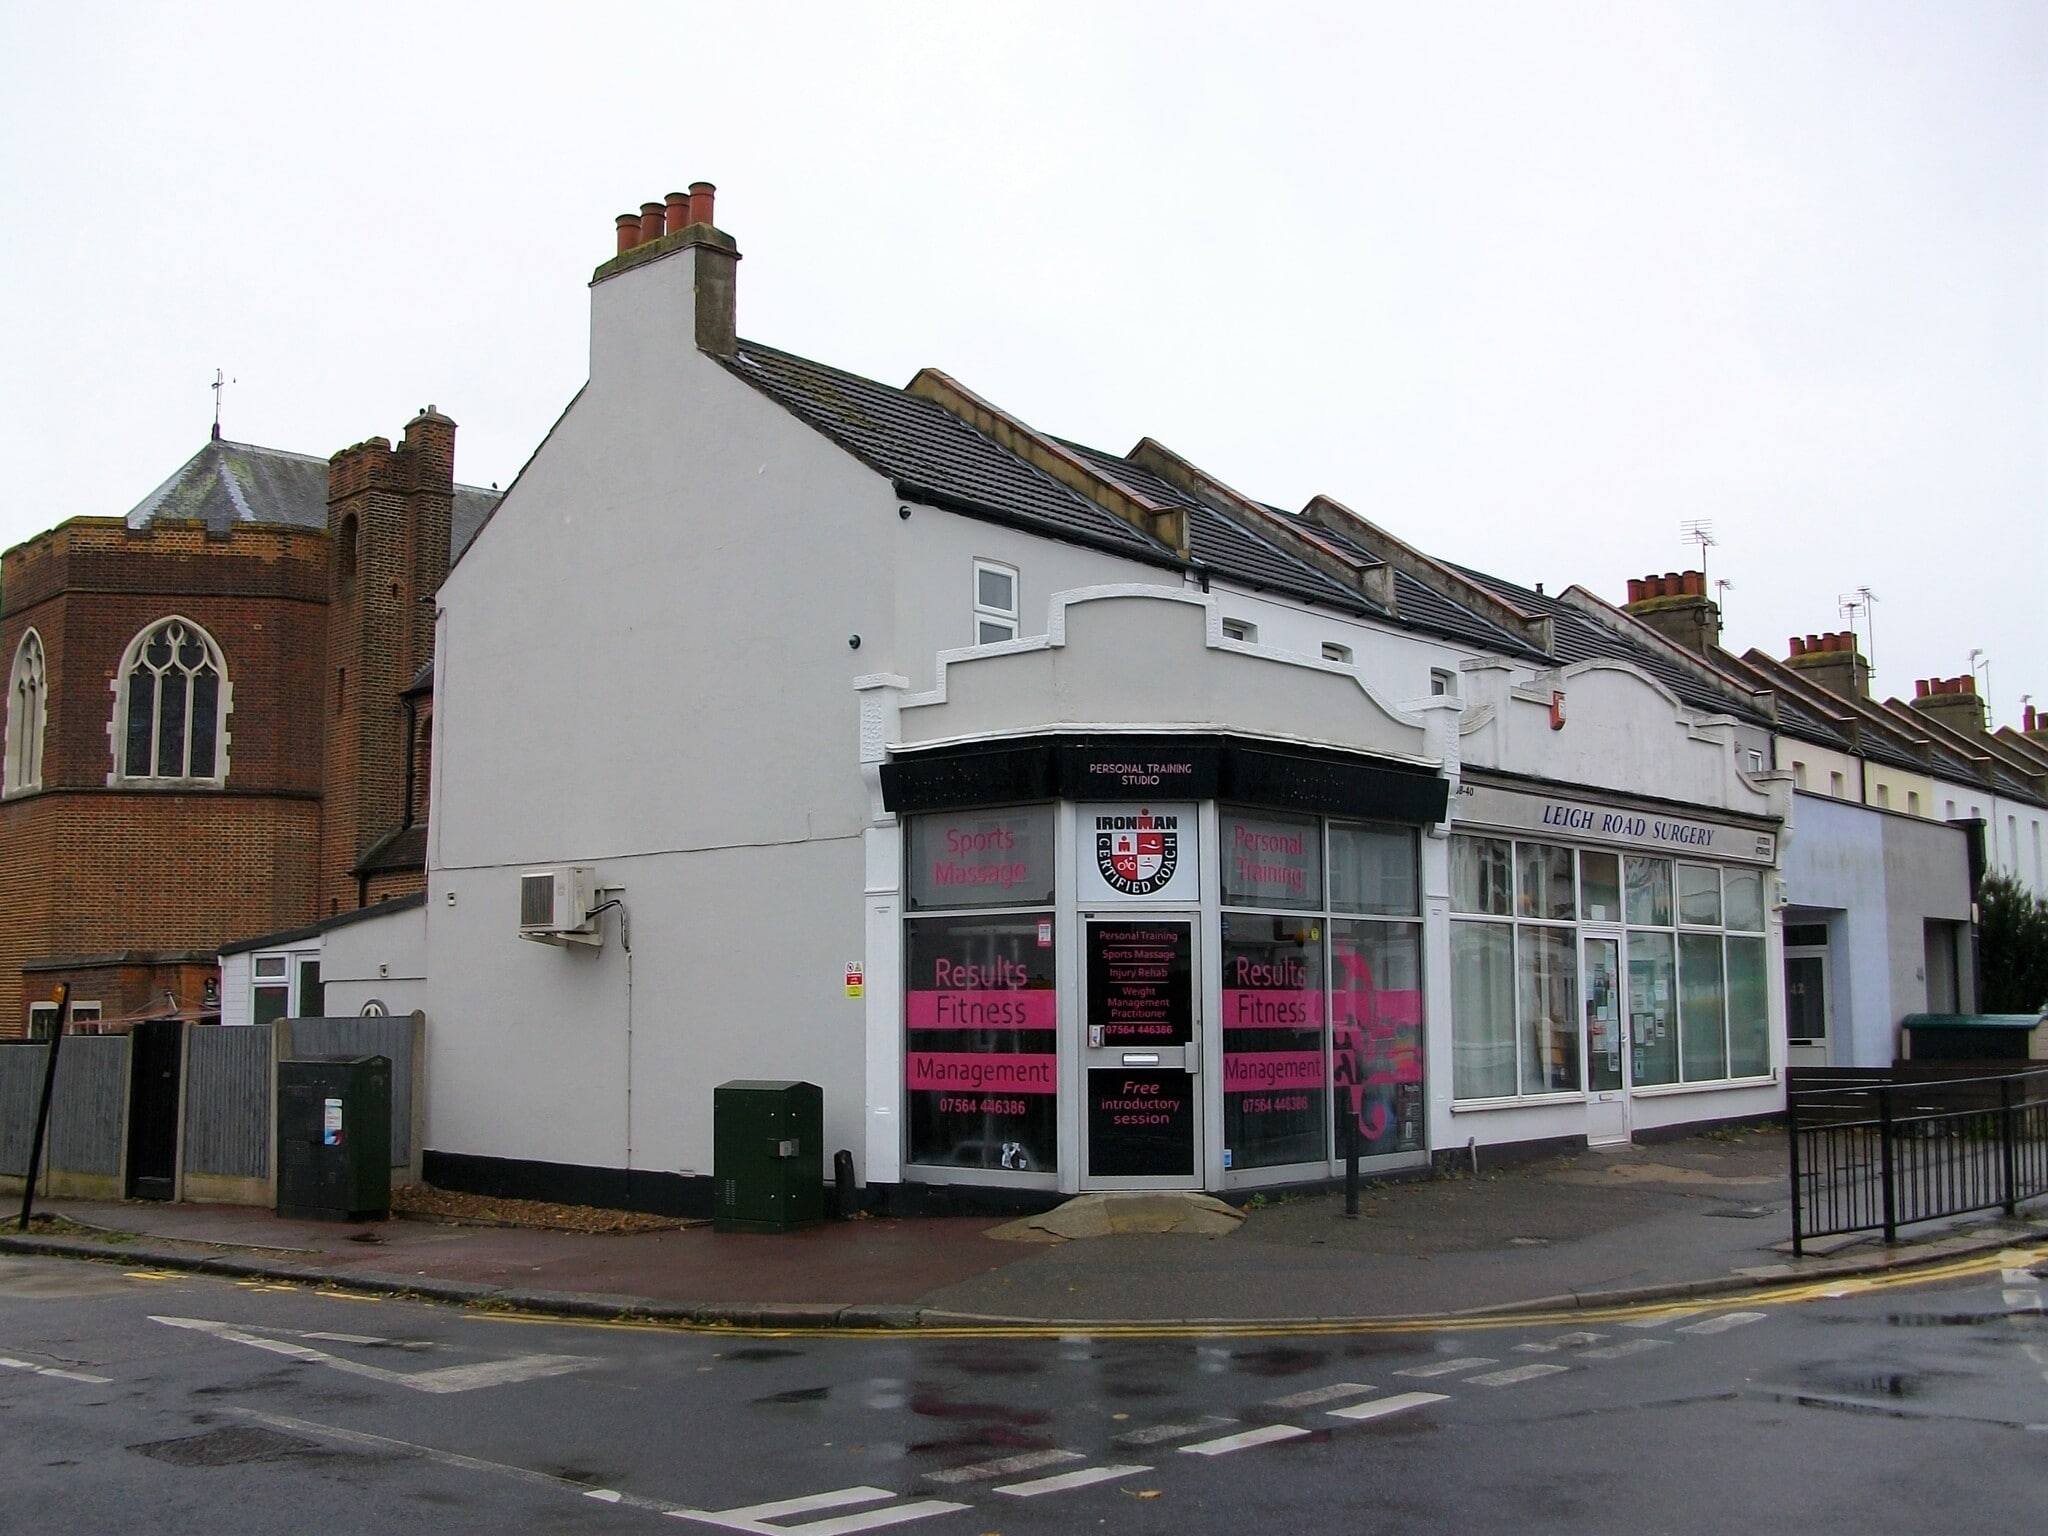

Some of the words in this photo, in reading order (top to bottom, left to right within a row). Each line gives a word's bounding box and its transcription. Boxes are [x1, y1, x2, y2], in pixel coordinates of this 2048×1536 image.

[1089, 763, 1144, 773] PERSONAL
[1147, 763, 1192, 773] TRAINING
[1122, 775, 1160, 785] STUDIO
[1096, 809, 1177, 830] IRONMAN
[1542, 805, 1595, 830] LEIGH
[1602, 814, 1646, 837] ROAD
[1653, 821, 1716, 846] SURGERY
[946, 827, 1015, 858] Sports
[1233, 824, 1302, 855] Personal
[1099, 838, 1151, 893] CERTIFIED
[1155, 838, 1176, 885] COACH
[934, 861, 1027, 890] Massage
[1236, 856, 1303, 893] Training
[1099, 930, 1139, 940] Personal
[1140, 931, 1178, 942] Training
[1102, 949, 1133, 960] Sports
[1134, 949, 1176, 960] Massage
[935, 955, 1028, 988] Results
[1109, 968, 1136, 979] Injury
[1138, 968, 1168, 977] Rehab
[1236, 955, 1307, 988] Results
[1122, 987, 1156, 998] Weight
[937, 995, 1027, 1025] Fitness
[1107, 998, 1170, 1009] Management
[1238, 994, 1307, 1024] Fitness
[1111, 1009, 1166, 1018] Practitioner
[1106, 1025, 1135, 1034] 07564
[1137, 1025, 1173, 1034] 446386
[916, 1057, 1050, 1088] Management
[1225, 1057, 1321, 1086] Management
[1122, 1081, 1160, 1094] Free
[940, 1098, 977, 1114] 07564
[980, 1099, 1026, 1115] 446386
[1101, 1097, 1180, 1112] introductory
[1242, 1098, 1272, 1114] 07564
[1114, 1112, 1170, 1125] session
